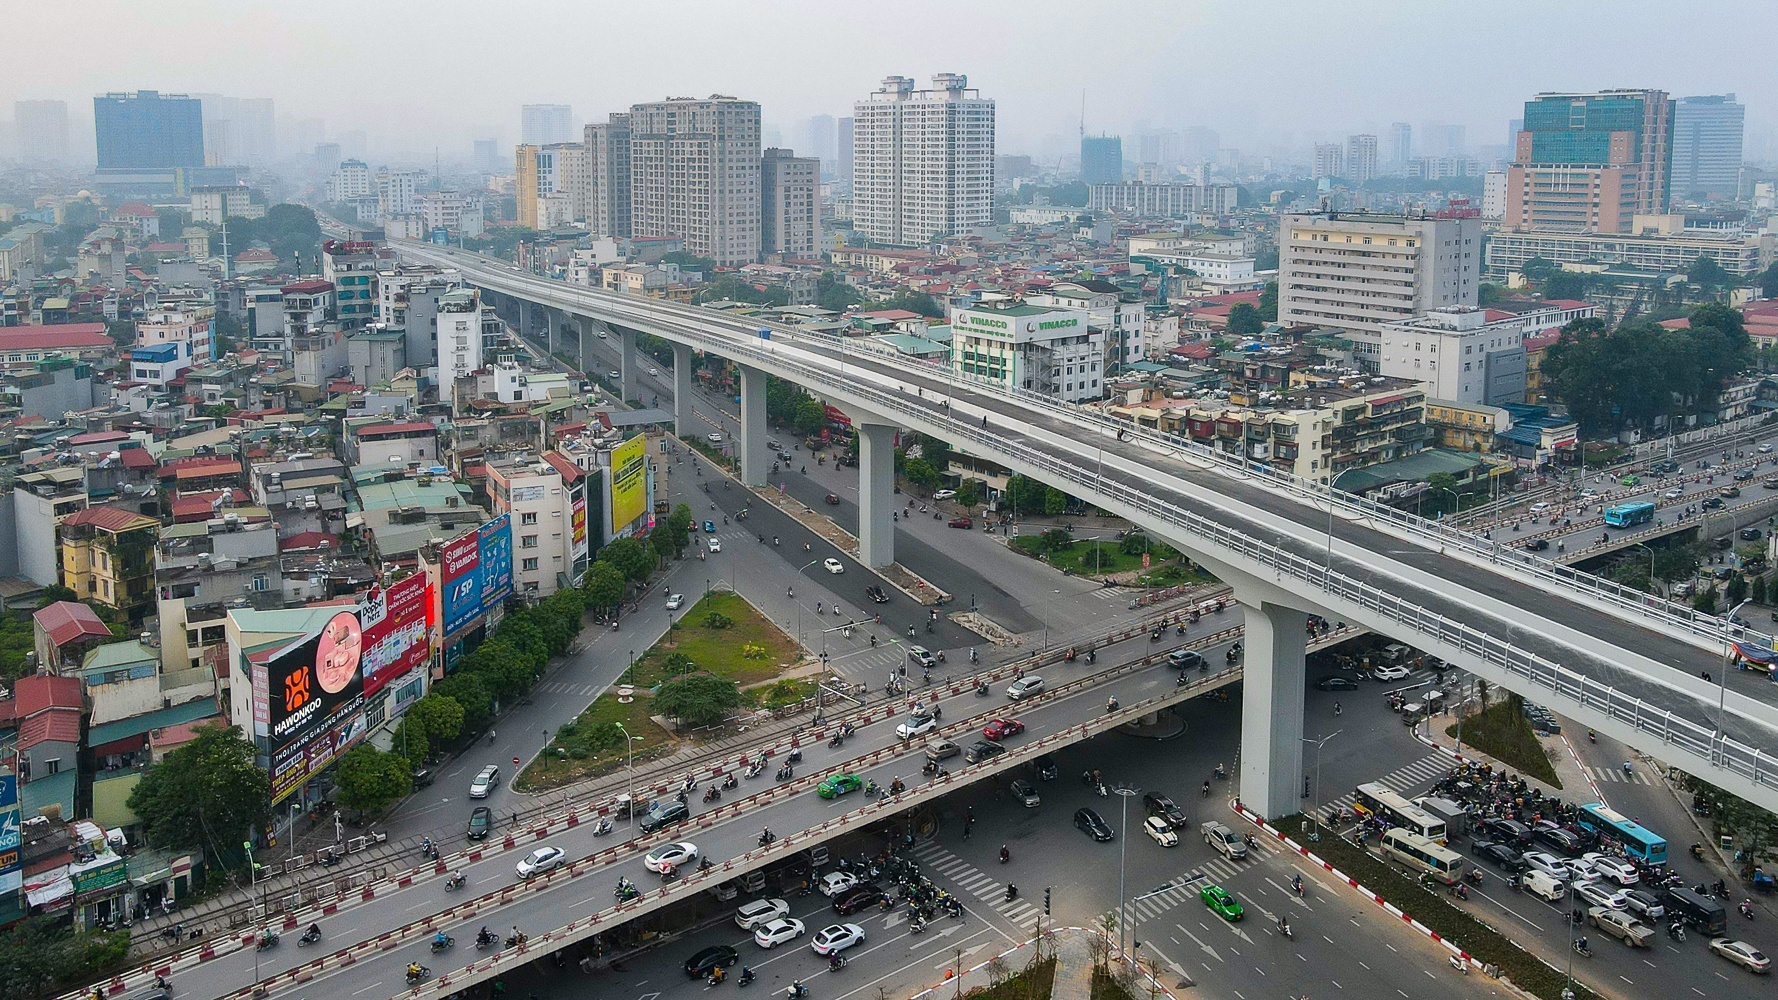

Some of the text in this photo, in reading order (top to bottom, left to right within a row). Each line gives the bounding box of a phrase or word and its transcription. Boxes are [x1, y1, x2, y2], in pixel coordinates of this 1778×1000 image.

[970, 316, 1008, 329] VINACCO
[1039, 319, 1078, 330] VINACCO
[461, 578, 473, 596] SP
[363, 596, 384, 617] Doppel
[367, 611, 380, 624] herz
[275, 698, 321, 735] HAWONKOO
[290, 736, 308, 752] TRANG
[310, 729, 320, 738] GIA
[0, 836, 16, 847] NỘI
